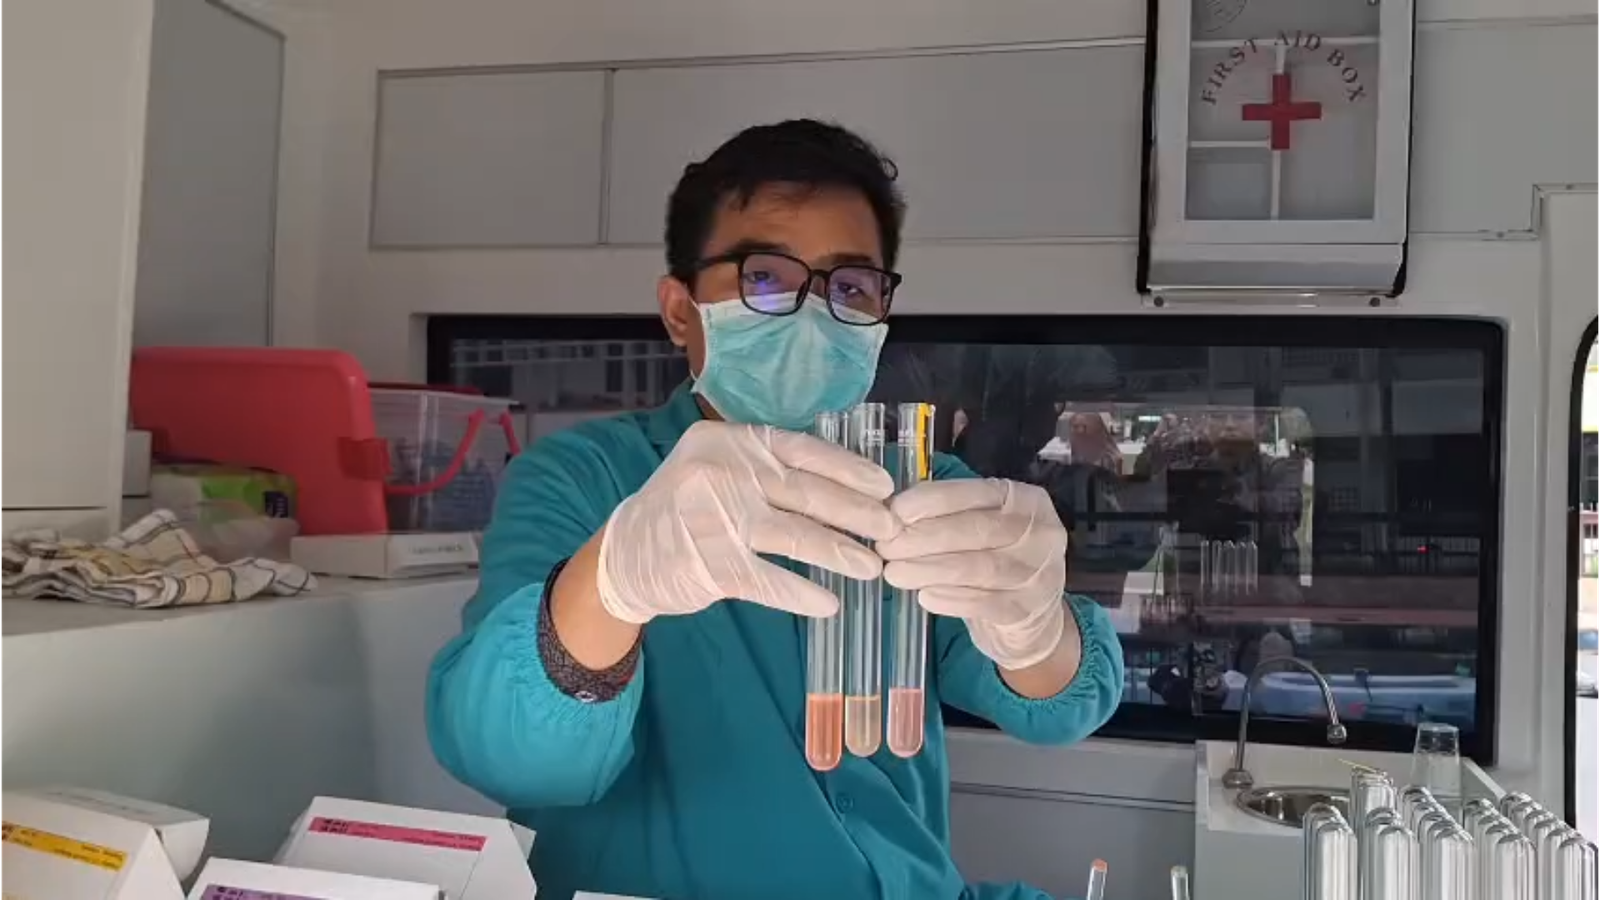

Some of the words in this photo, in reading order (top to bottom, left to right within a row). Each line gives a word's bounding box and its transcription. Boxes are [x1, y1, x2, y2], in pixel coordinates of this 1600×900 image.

[1201, 38, 1260, 105] FIRST
[1274, 30, 1321, 51] AID
[1327, 48, 1367, 101] BOX
